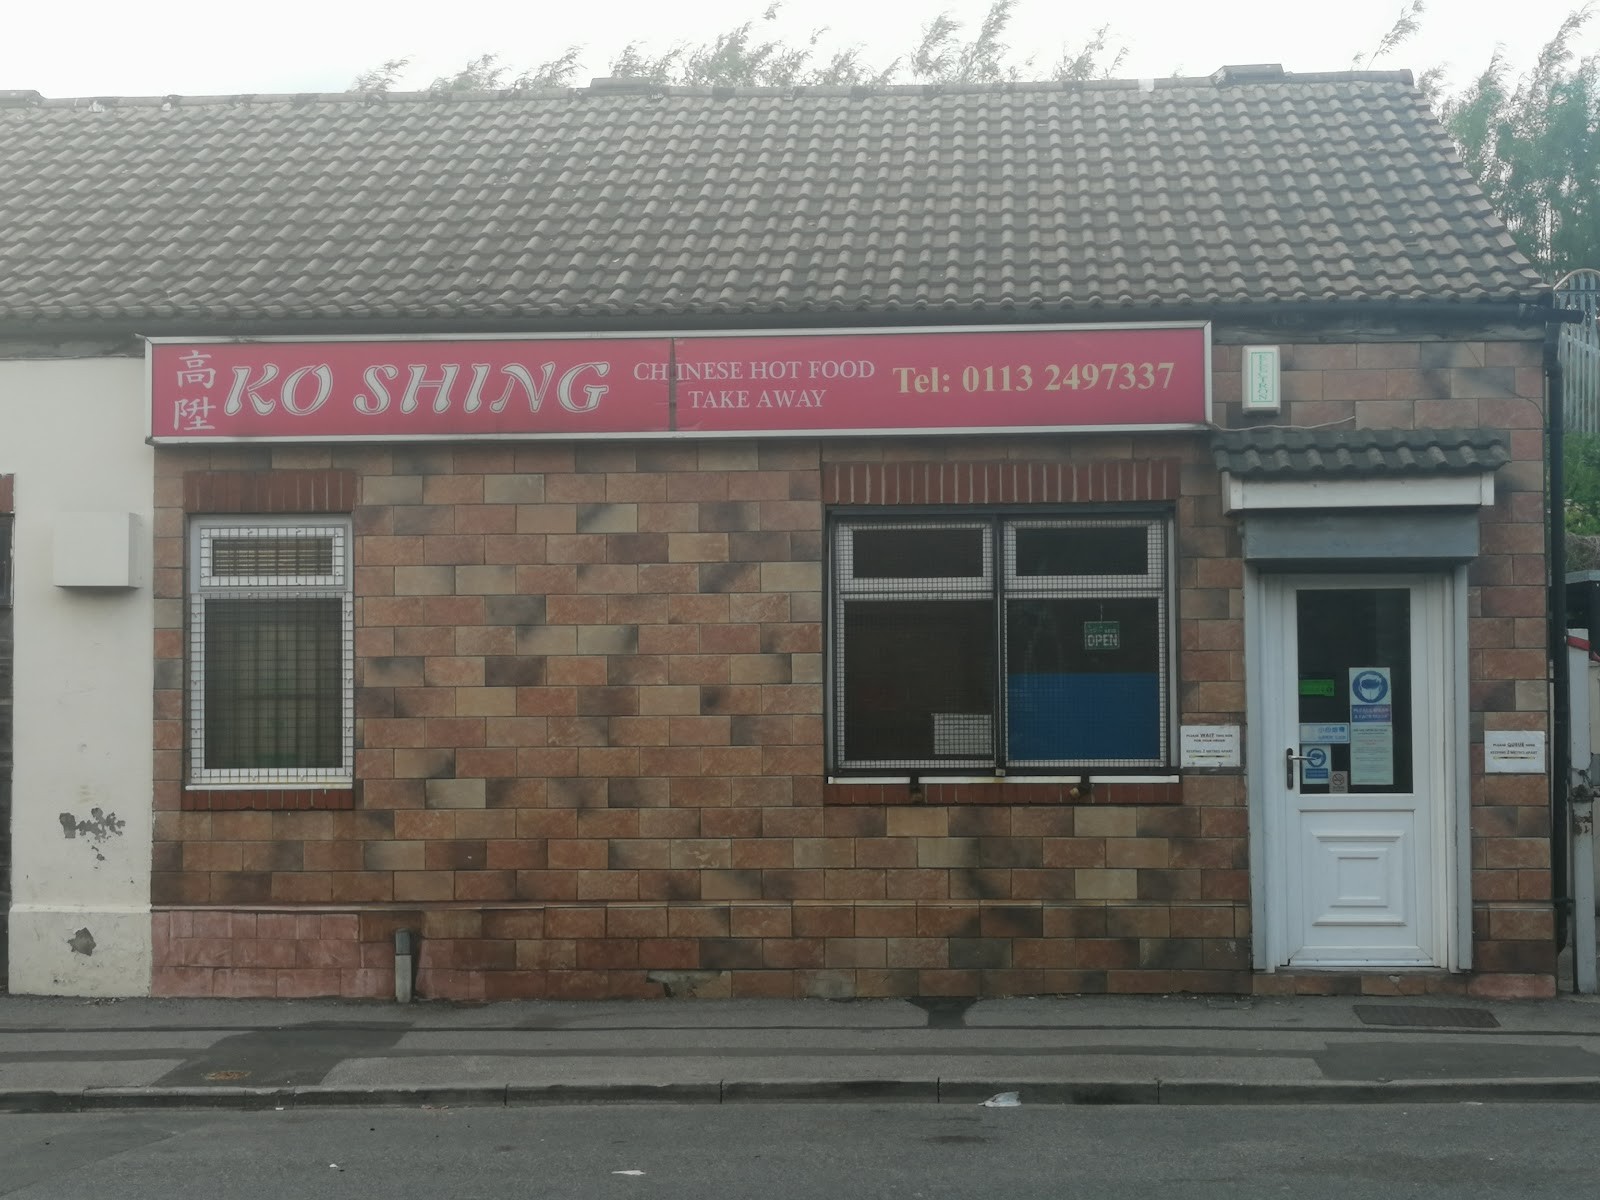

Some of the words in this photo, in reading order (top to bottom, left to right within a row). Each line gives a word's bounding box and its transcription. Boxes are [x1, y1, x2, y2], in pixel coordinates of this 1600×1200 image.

[633, 361, 743, 381] CHINESE
[750, 361, 802, 380] HOT
[808, 360, 875, 379] FOOD
[893, 367, 950, 393] Tel:
[962, 365, 1033, 393] 0113
[1044, 362, 1175, 391] 2497337
[224, 363, 333, 416] KO
[353, 362, 610, 414] SHING
[688, 391, 750, 409] TAKE
[757, 389, 827, 408] AWAY
[1087, 634, 1118, 647] OPEN
